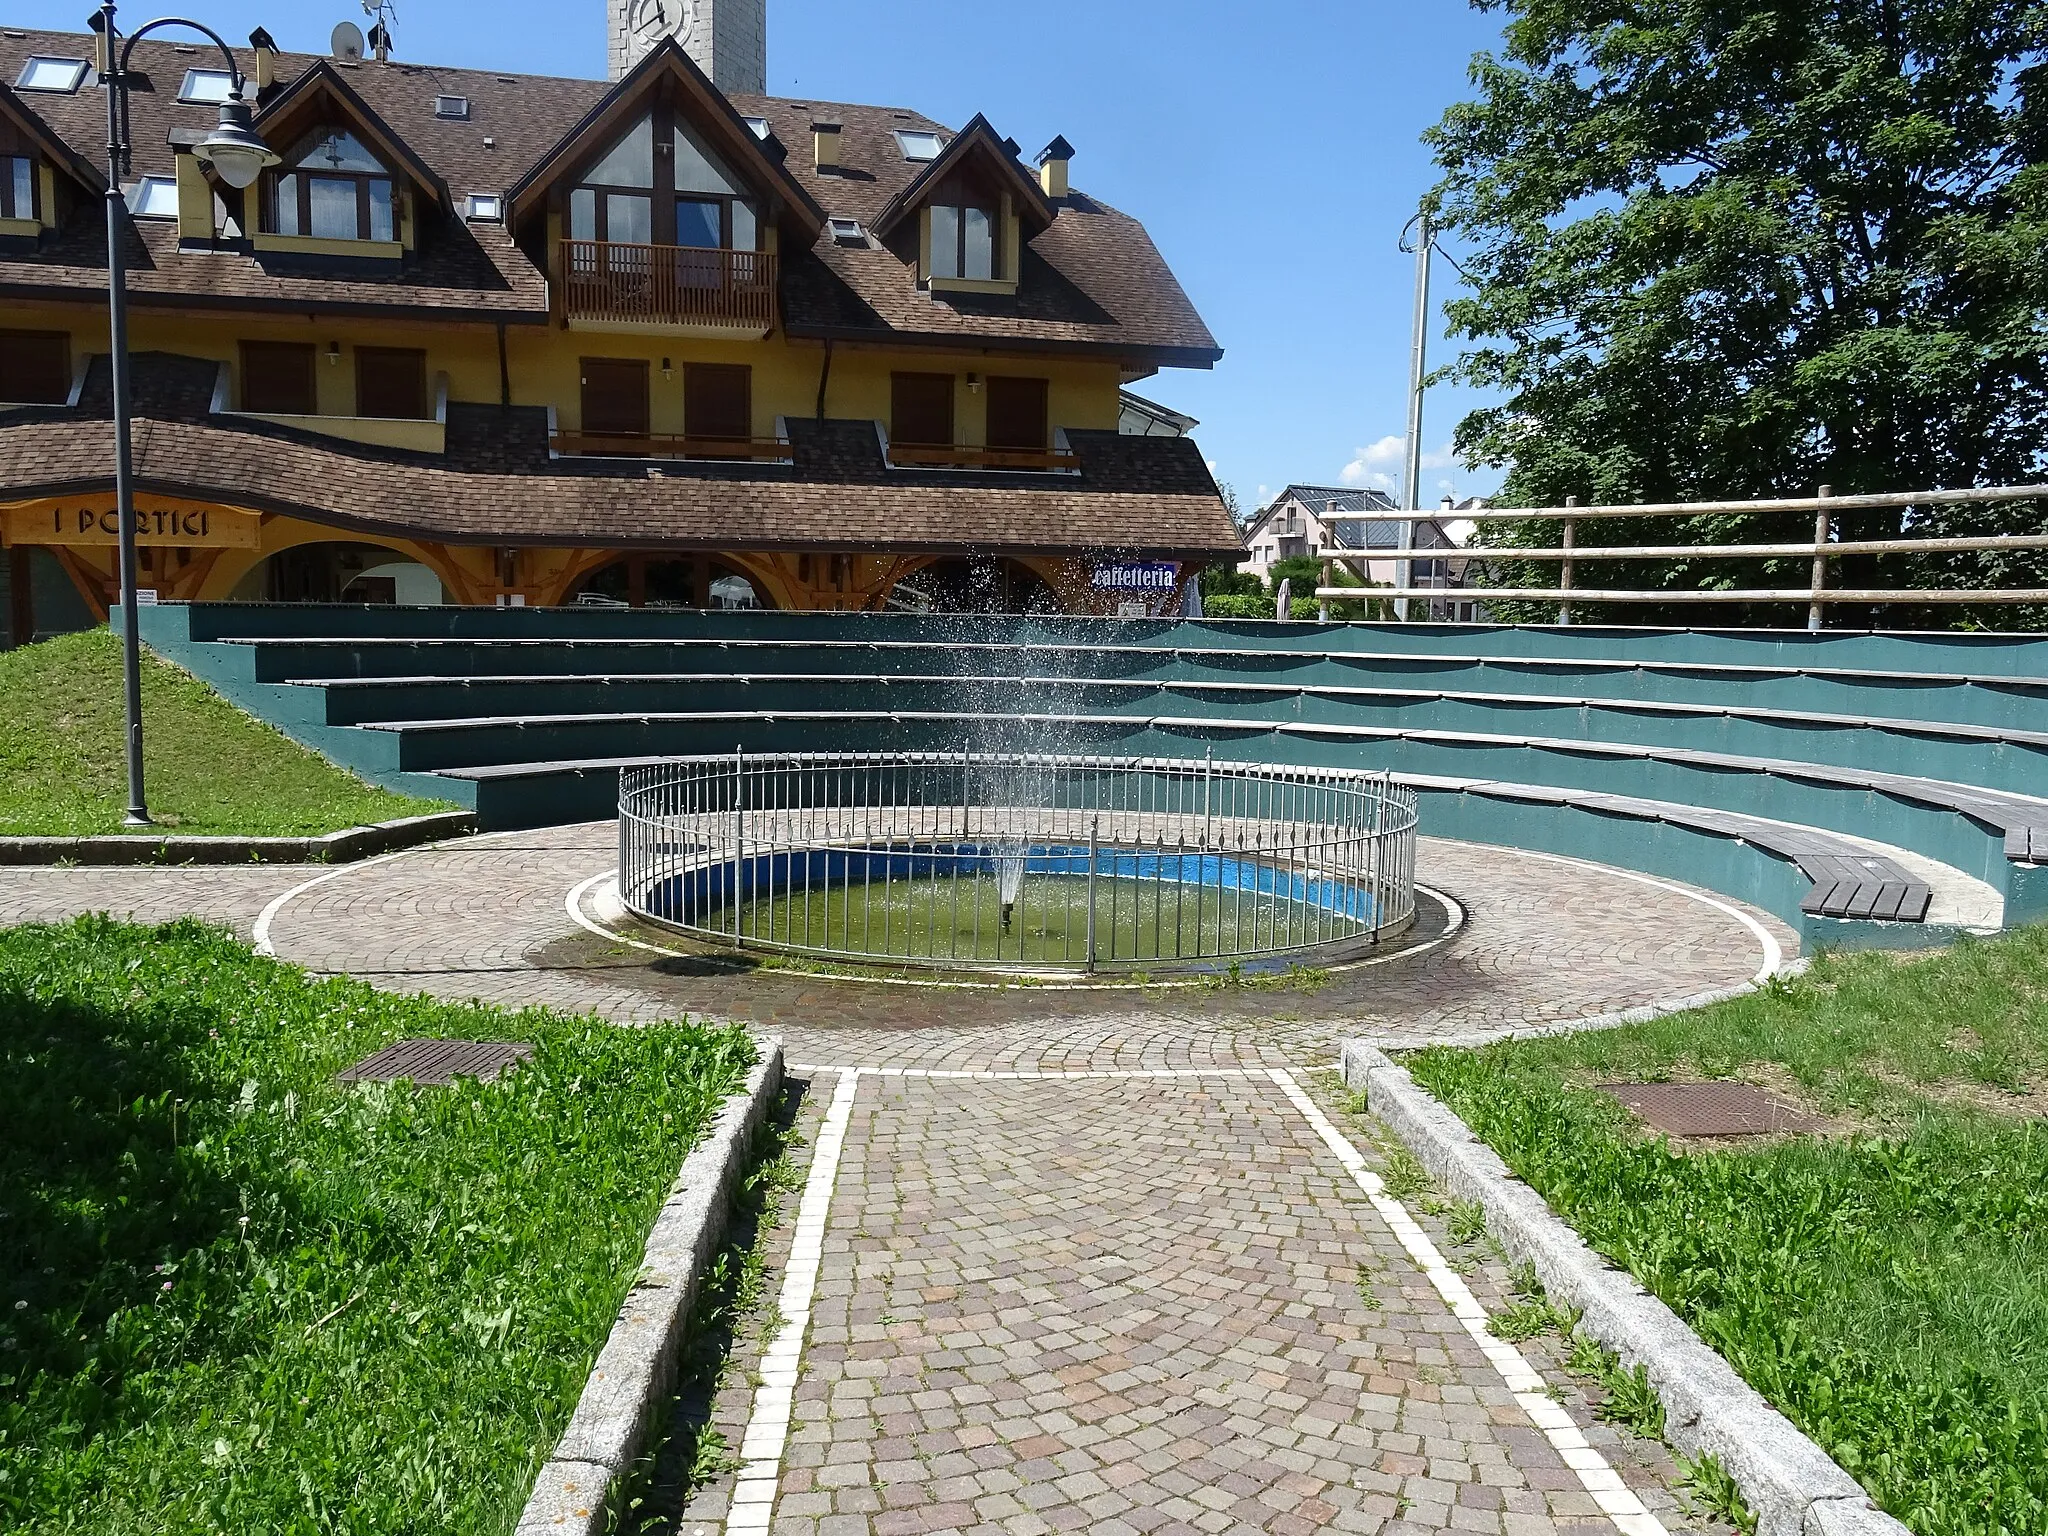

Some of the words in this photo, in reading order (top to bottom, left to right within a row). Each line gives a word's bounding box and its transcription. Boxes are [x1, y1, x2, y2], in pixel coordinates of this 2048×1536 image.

[54, 508, 62, 533] I
[79, 508, 209, 536] PORTICI
[1094, 566, 1173, 587] caffetteria
